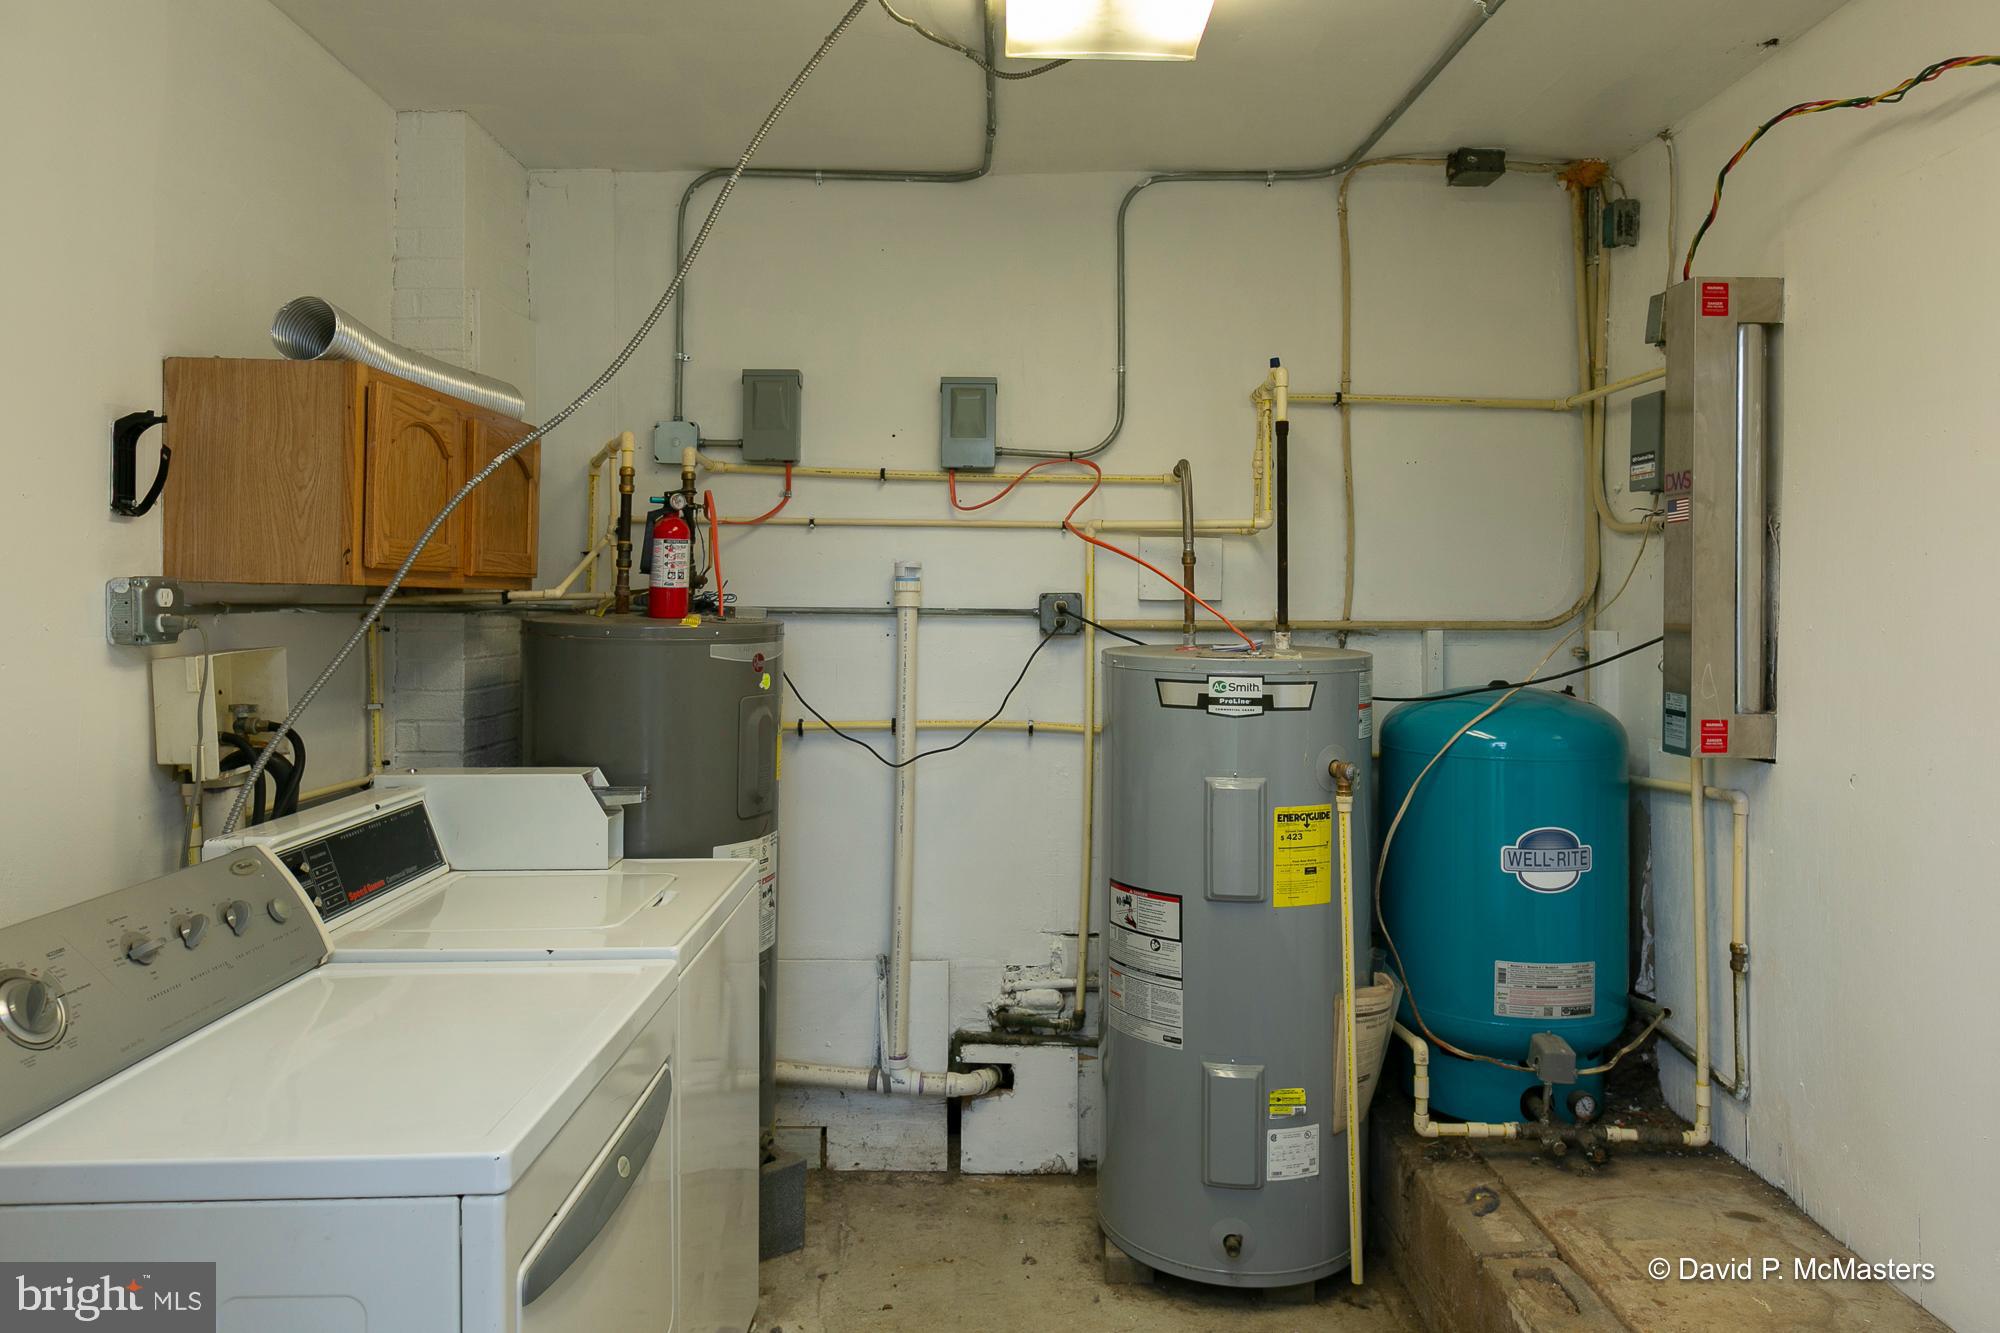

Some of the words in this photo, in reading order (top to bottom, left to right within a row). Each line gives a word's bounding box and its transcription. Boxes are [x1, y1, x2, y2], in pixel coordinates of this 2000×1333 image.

[1665, 470, 1692, 492] DWS
[1219, 697, 1250, 705] ProLine
[1277, 811, 1331, 823] ENERGYGUIDE
[1286, 832, 1303, 841] 423
